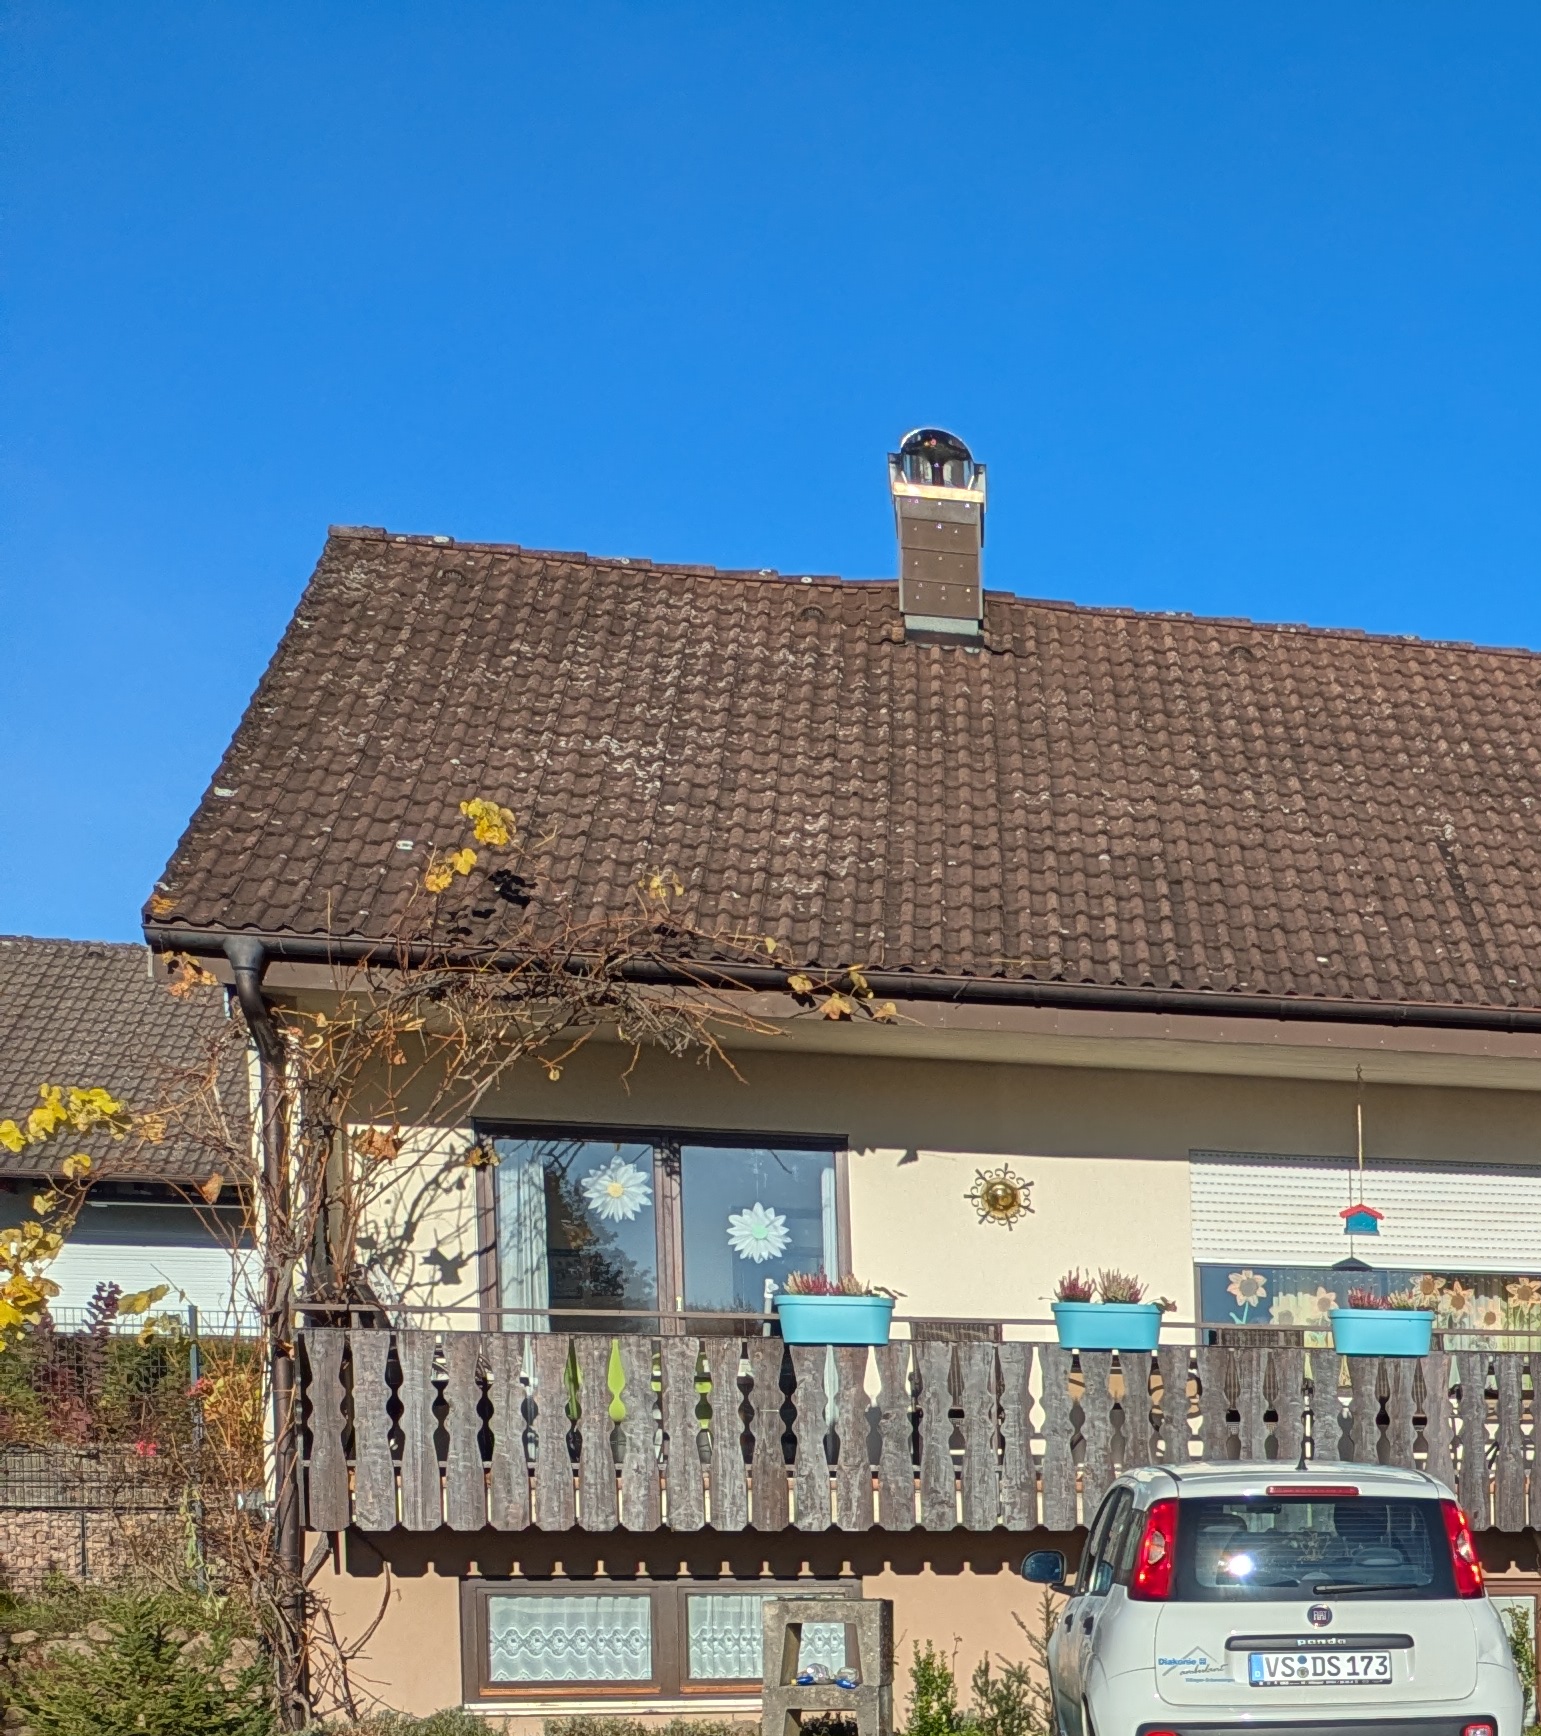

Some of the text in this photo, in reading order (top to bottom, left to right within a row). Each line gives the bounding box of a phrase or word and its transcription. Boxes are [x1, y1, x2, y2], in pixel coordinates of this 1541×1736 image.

[1312, 1610, 1328, 1621] FIAT
[1296, 1637, 1347, 1646] panda
[1158, 1657, 1197, 1666] Diakonie
[1264, 1655, 1389, 1678] VS DS 173
